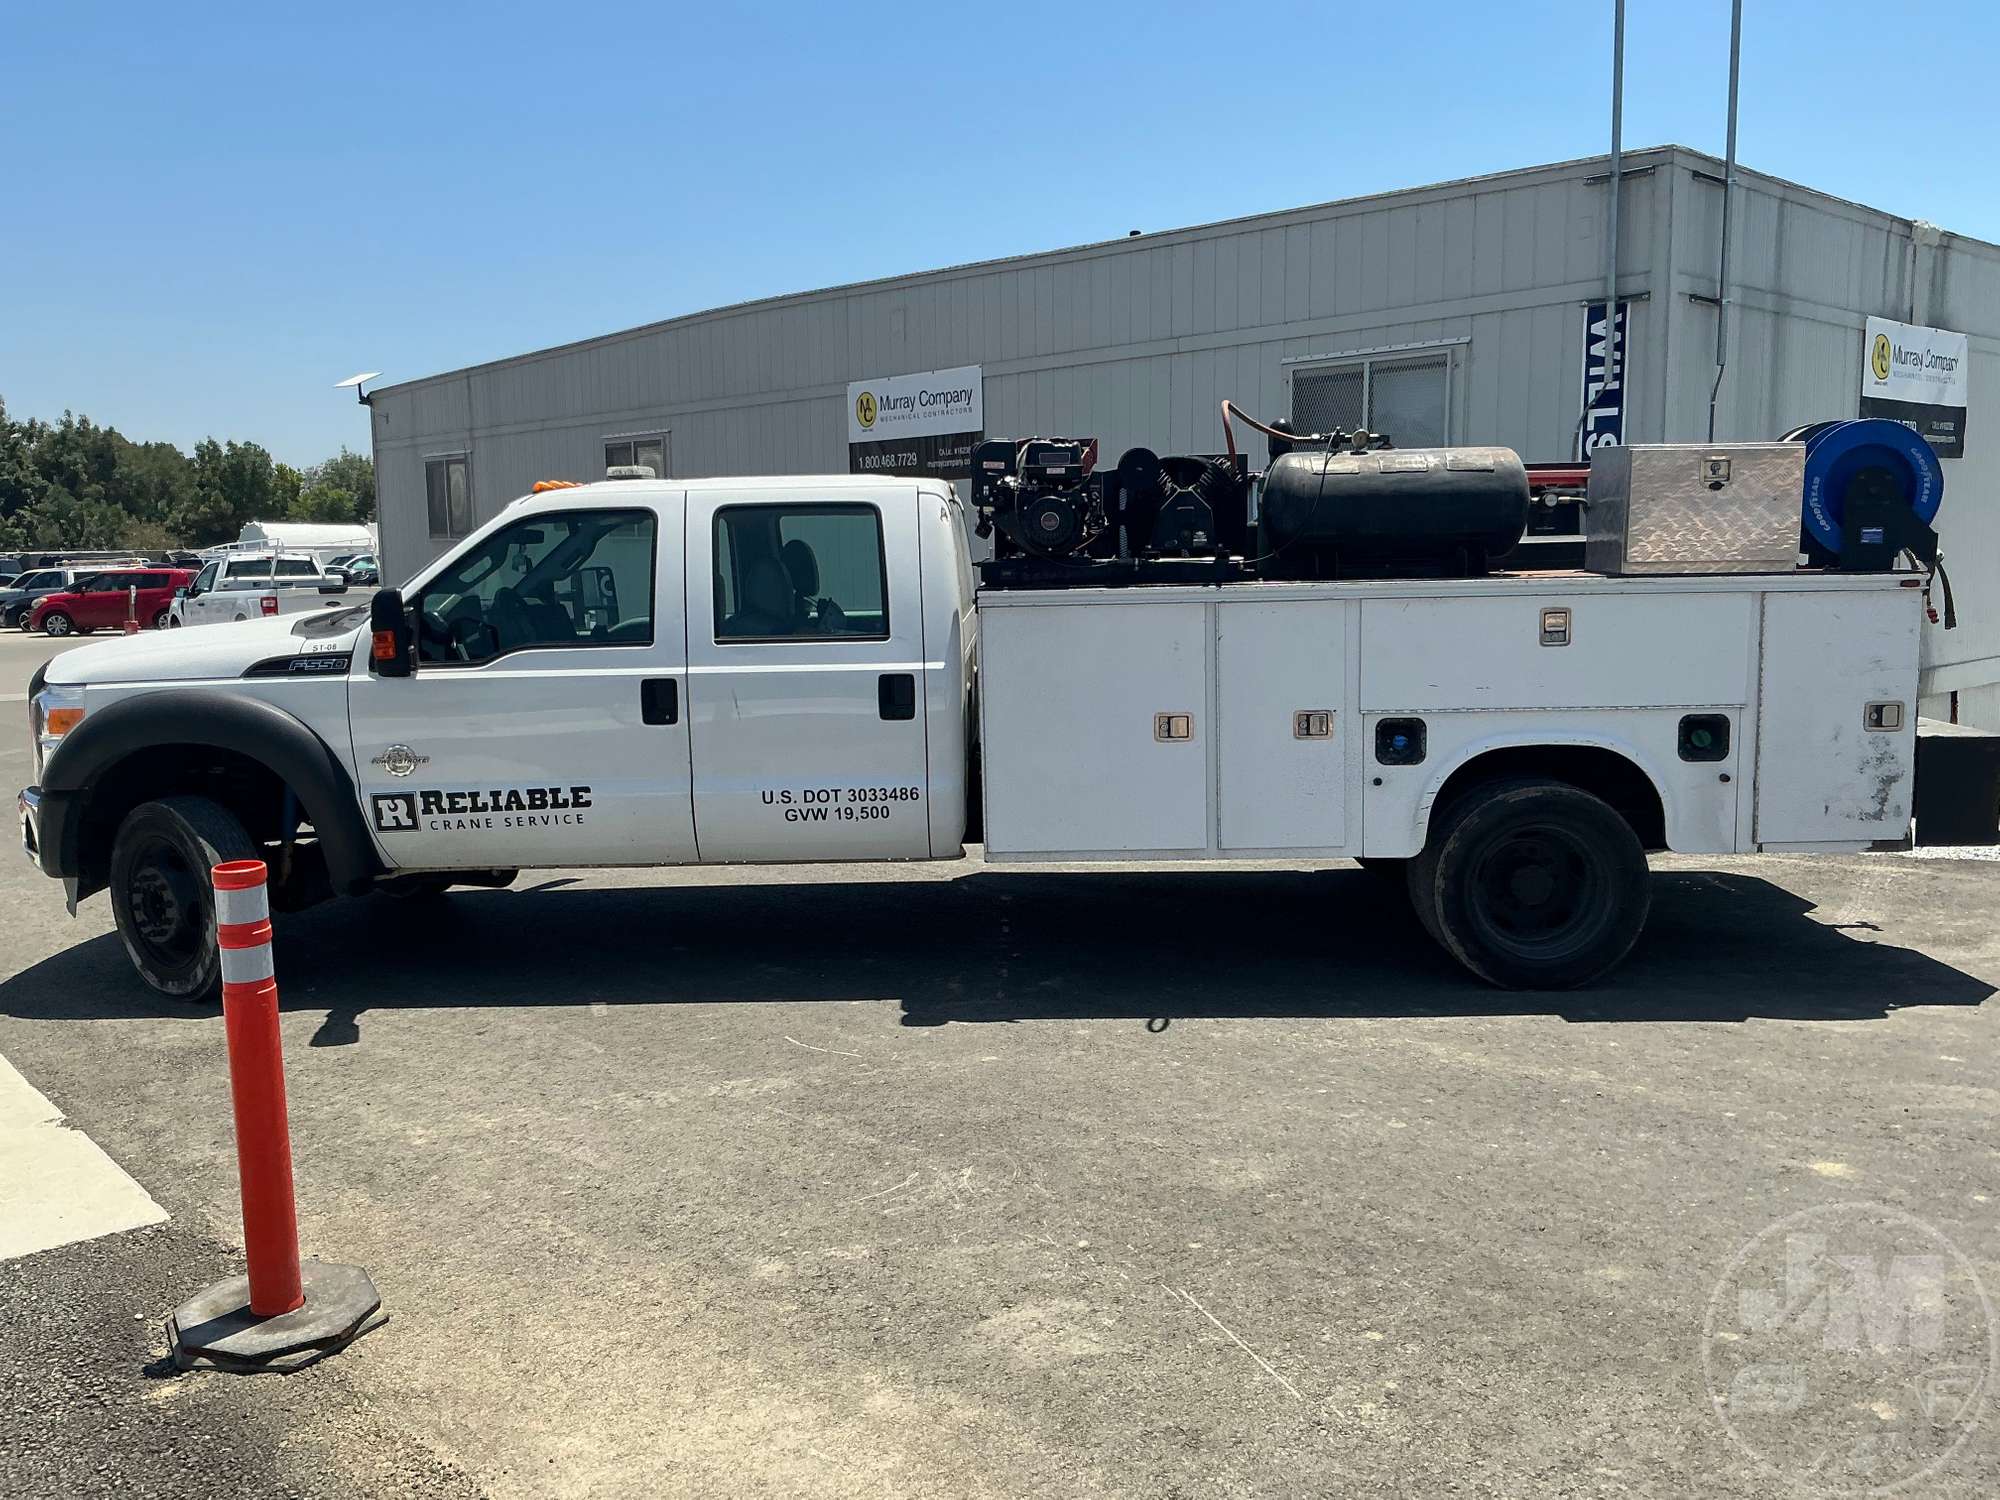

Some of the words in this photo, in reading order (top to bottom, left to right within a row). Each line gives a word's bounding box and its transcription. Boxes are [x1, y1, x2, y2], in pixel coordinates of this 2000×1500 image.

[1892, 344, 1923, 372] Murray
[879, 394, 916, 413] Murray
[918, 388, 974, 408] Company
[879, 411, 921, 423] MECHANICAL
[923, 406, 973, 418] CONTRACTORS
[858, 452, 918, 469] 1.800.468.7729
[1909, 447, 1933, 504] GOODYEAR
[1808, 475, 1831, 532] GOODYEAR
[419, 786, 593, 815] RELIABLE
[761, 790, 797, 804] U.S.
[803, 788, 841, 804] DOT
[847, 787, 920, 802] 3033486
[429, 817, 494, 831] CRANE
[504, 813, 585, 828] SERVICE
[784, 808, 829, 822] GVW
[834, 806, 890, 822] 19,500
